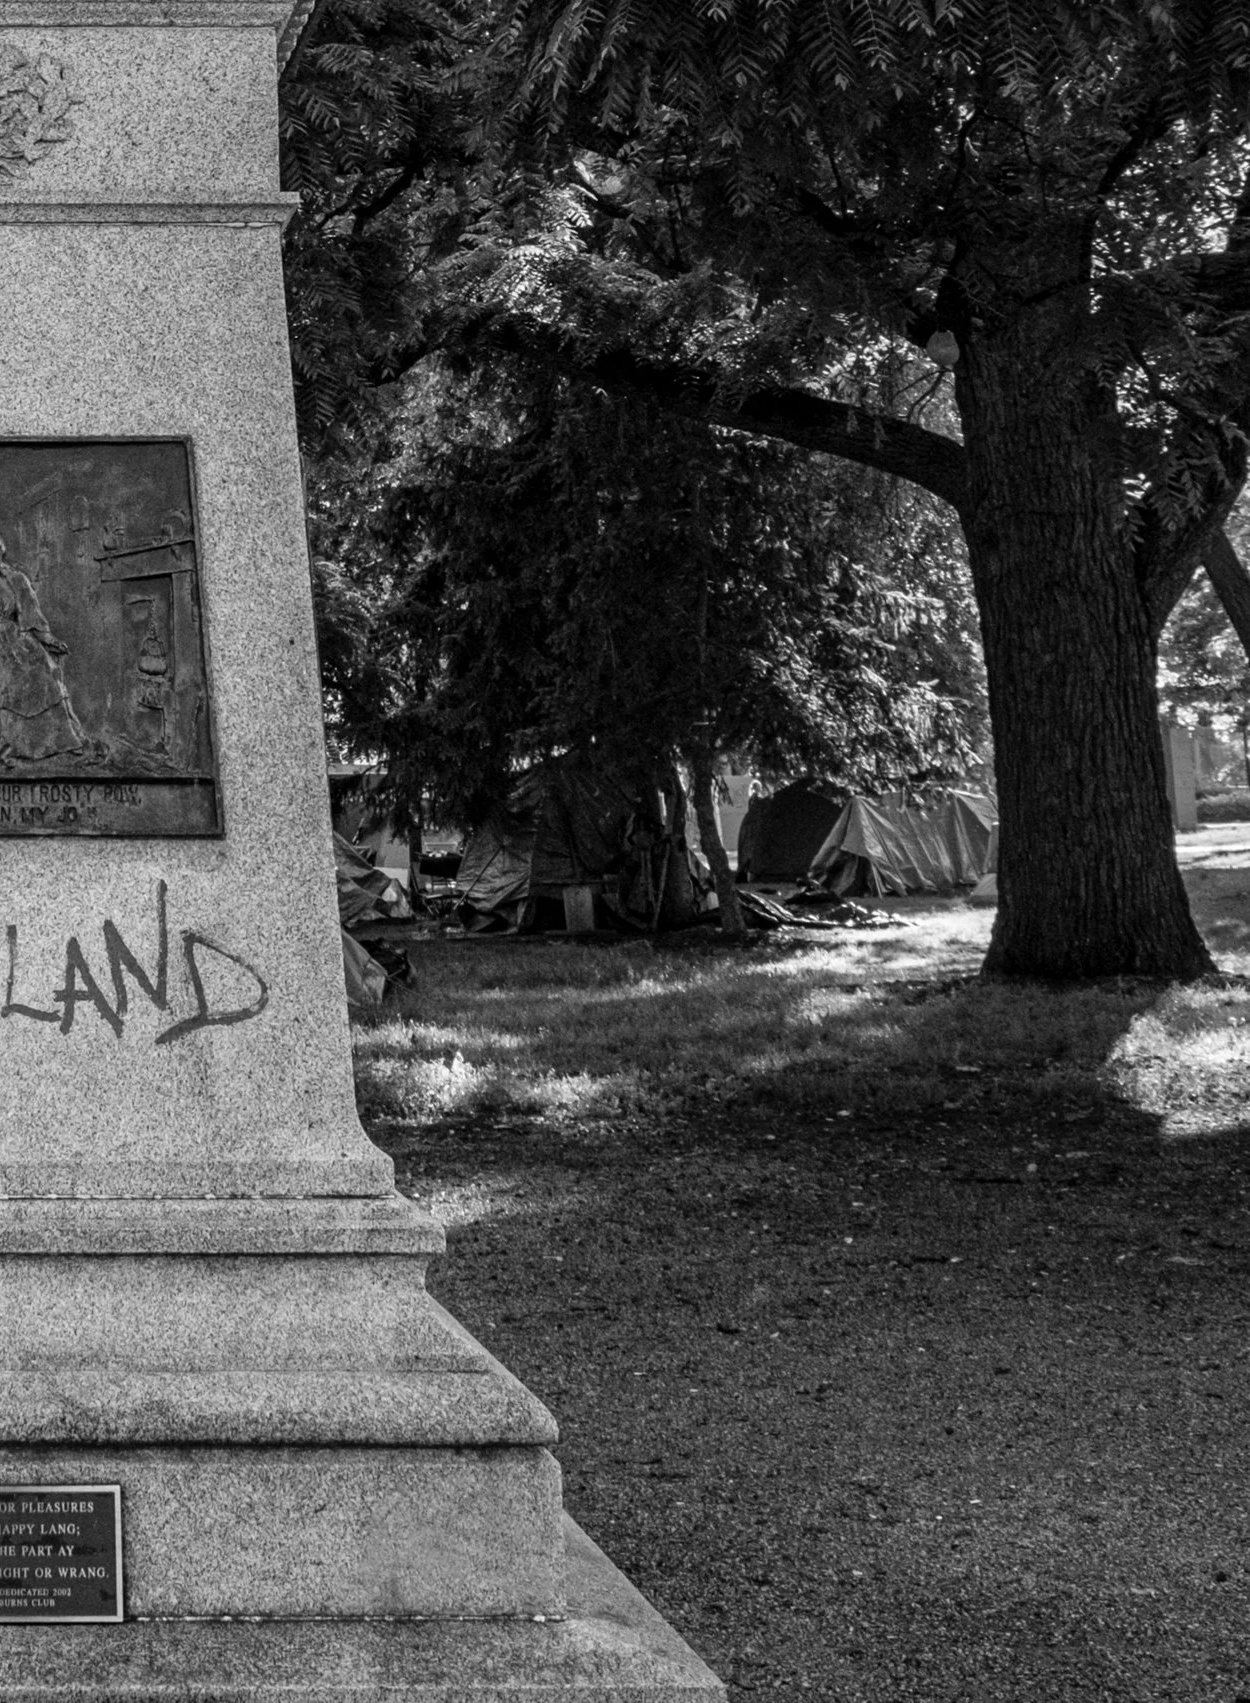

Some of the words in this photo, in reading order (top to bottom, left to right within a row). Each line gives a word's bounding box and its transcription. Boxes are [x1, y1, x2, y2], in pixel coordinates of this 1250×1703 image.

[21, 805, 49, 823] MY
[0, 879, 269, 1045] LAND
[21, 1501, 94, 1513] PLEASURES
[40, 1523, 80, 1536] LANG;
[21, 1545, 53, 1556] PART
[58, 1545, 75, 1556] AY
[34, 1567, 53, 1578] OR
[57, 1567, 110, 1578] WRANG.
[52, 1588, 72, 1597] 2002
[31, 1598, 56, 1607] CLUB
